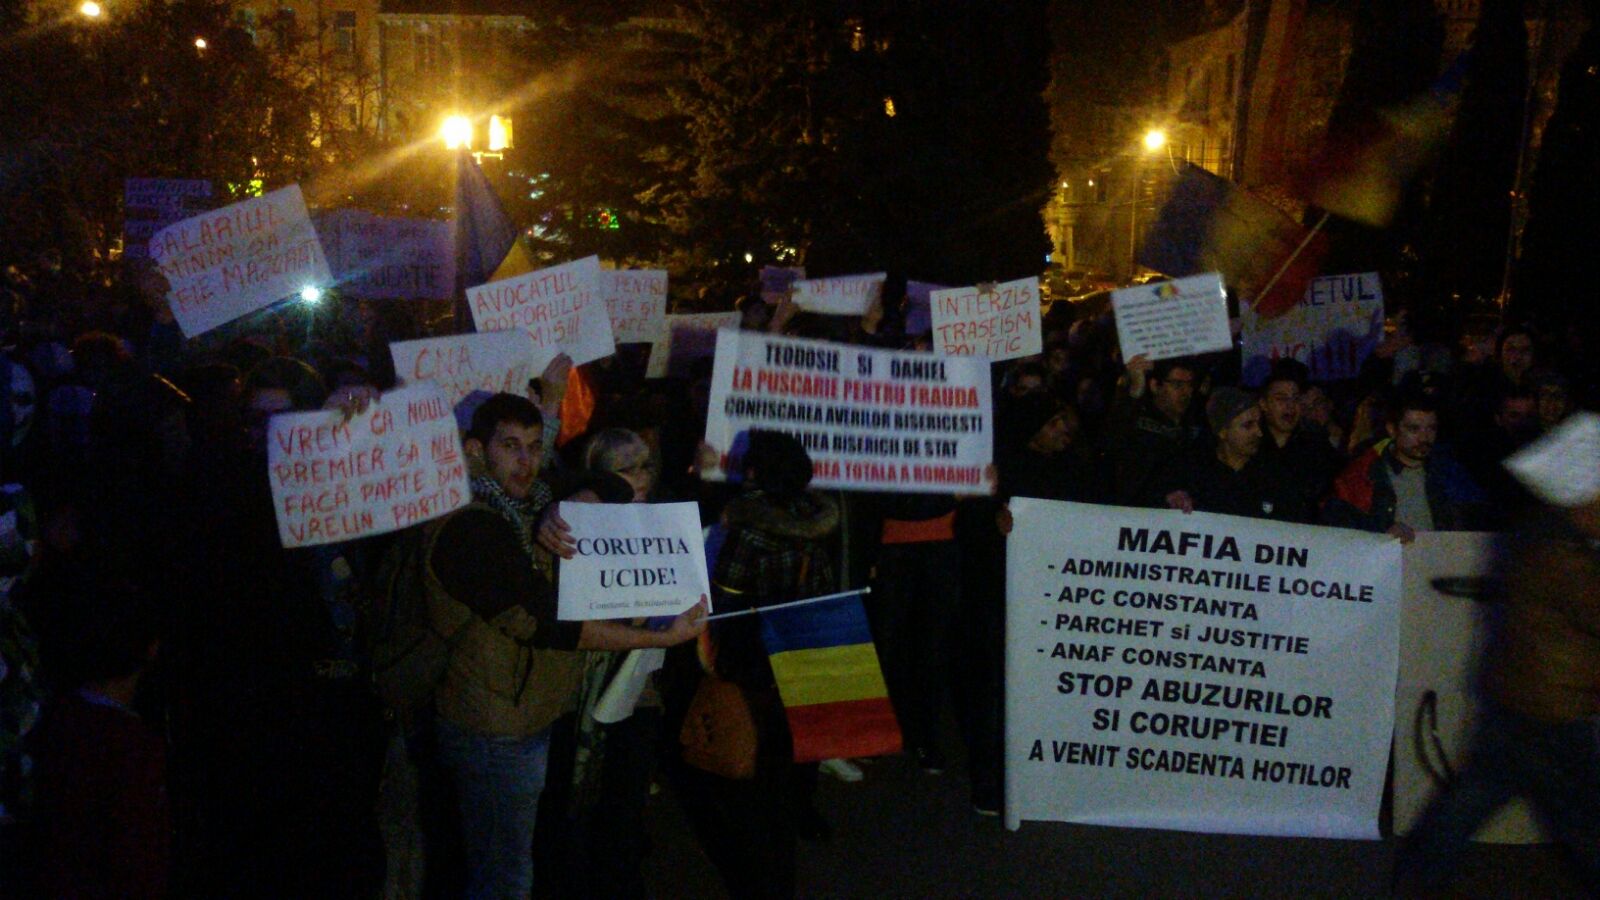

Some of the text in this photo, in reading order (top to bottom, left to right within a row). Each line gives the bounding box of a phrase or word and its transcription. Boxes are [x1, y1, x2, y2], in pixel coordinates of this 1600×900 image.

[476, 271, 579, 315] AVOCATUL
[938, 286, 1031, 317] INTERZIS
[937, 311, 1033, 341] TRASEISM
[765, 343, 947, 382] TEODOSIE SI DANIEL
[732, 367, 980, 408] LA PUSCARIE PENTRU FRAUDA
[277, 397, 448, 455] VREM CA NOUL
[724, 397, 983, 432] CONFISCAREA AVERILOR BISERICESTI
[275, 447, 384, 487] PREMIER
[398, 442, 419, 467] SA
[904, 439, 920, 457] DE
[925, 440, 958, 459] STAT
[360, 469, 425, 501] PARTE
[845, 460, 897, 483] TOTALA
[901, 463, 909, 483] A
[392, 488, 461, 528] PARTID
[577, 537, 690, 556] CORUPTIA
[1118, 527, 1308, 567] MAFIA DIN
[600, 568, 678, 588] UCIDE!
[1061, 558, 1270, 592] ADMINISTRATIILE
[1278, 579, 1374, 603] LOCALE
[1058, 586, 1105, 606] APC
[1113, 590, 1258, 621] CONSTANTA
[1055, 614, 1163, 639] PARCHET
[1171, 624, 1190, 641] si
[1197, 627, 1309, 655] JUSTITIE
[1050, 642, 1114, 663] ANAF
[1122, 647, 1266, 678] CONSTANTA
[1057, 672, 1333, 719] STOP ABUZURILOR
[1092, 708, 1288, 748] SI CORUPTIEI
[1028, 739, 1352, 789] A VENIT SCADENTA HOTILOR
